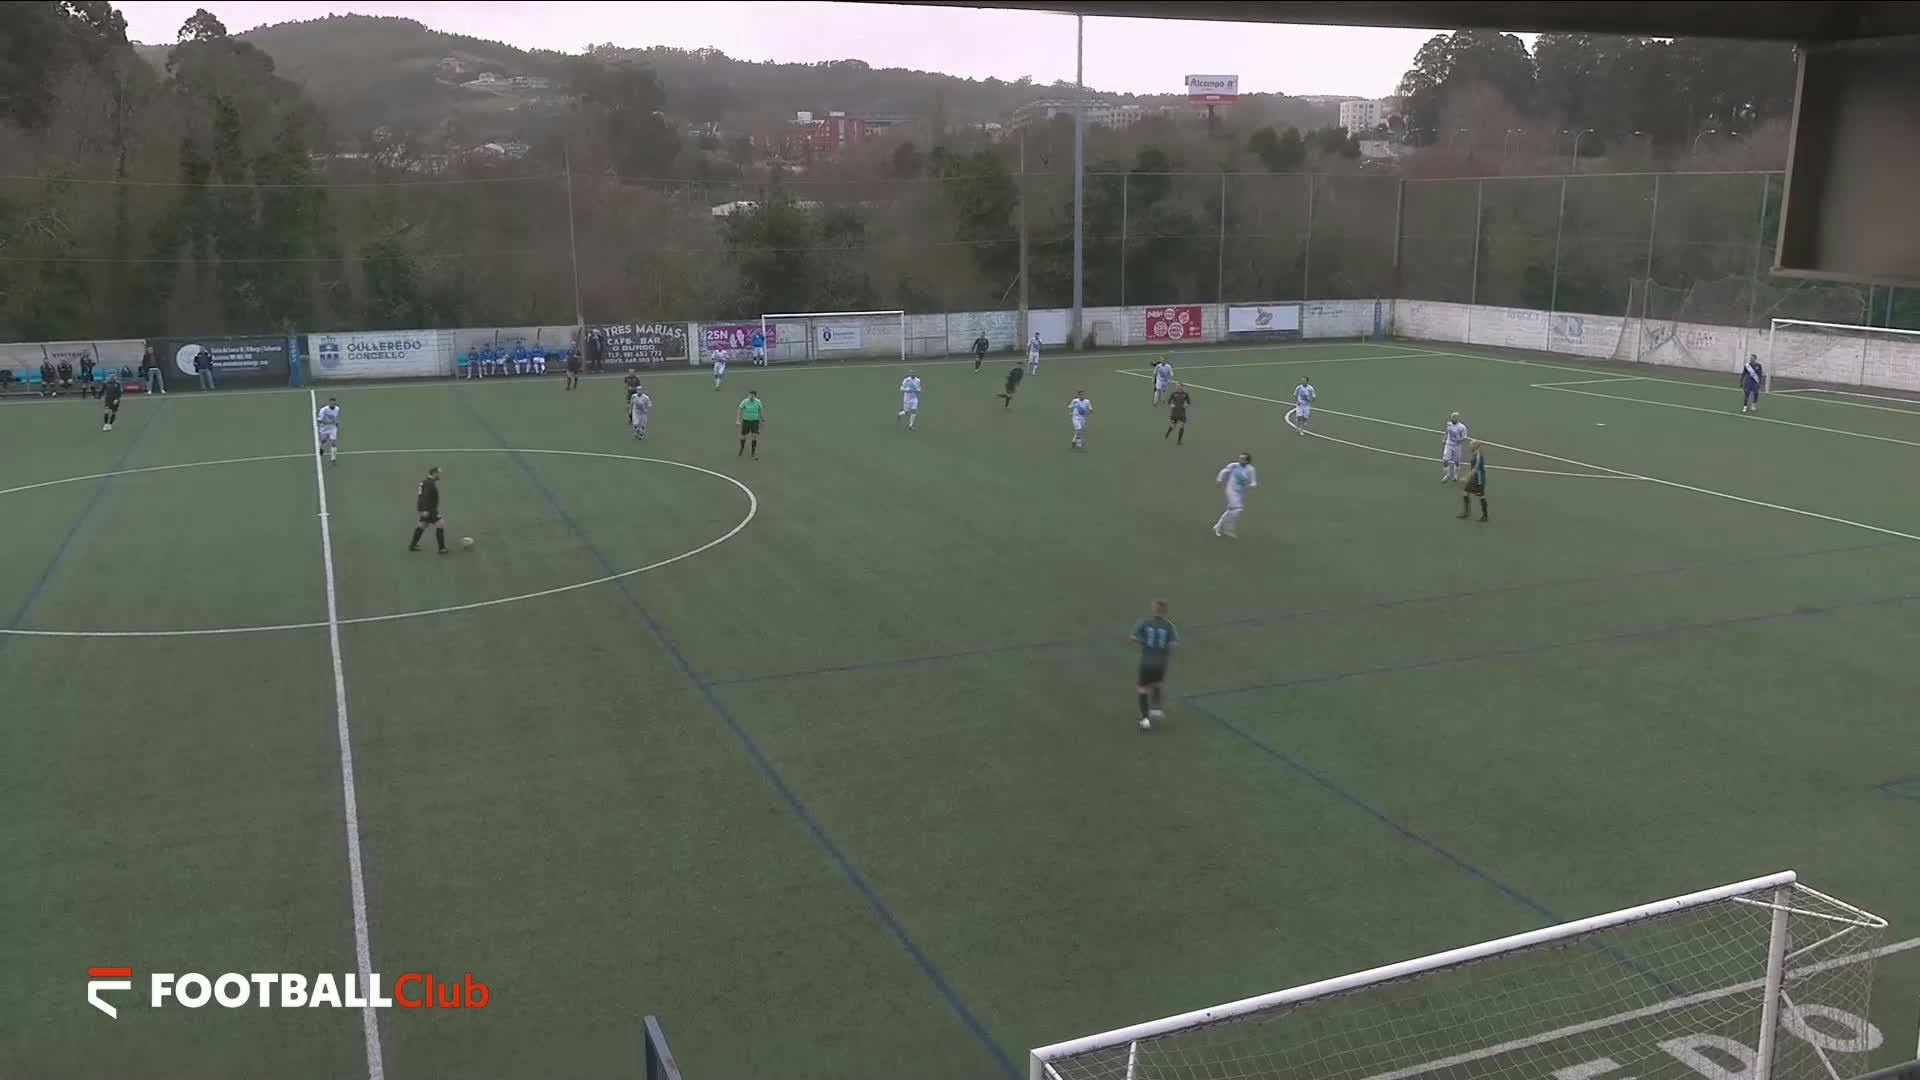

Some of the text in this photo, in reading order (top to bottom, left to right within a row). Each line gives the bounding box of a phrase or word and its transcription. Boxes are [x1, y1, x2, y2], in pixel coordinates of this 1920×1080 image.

[1191, 78, 1225, 88] Alcampo
[604, 324, 682, 338] TRES MARIAS
[707, 330, 728, 340] 25N
[640, 337, 661, 345] BAR
